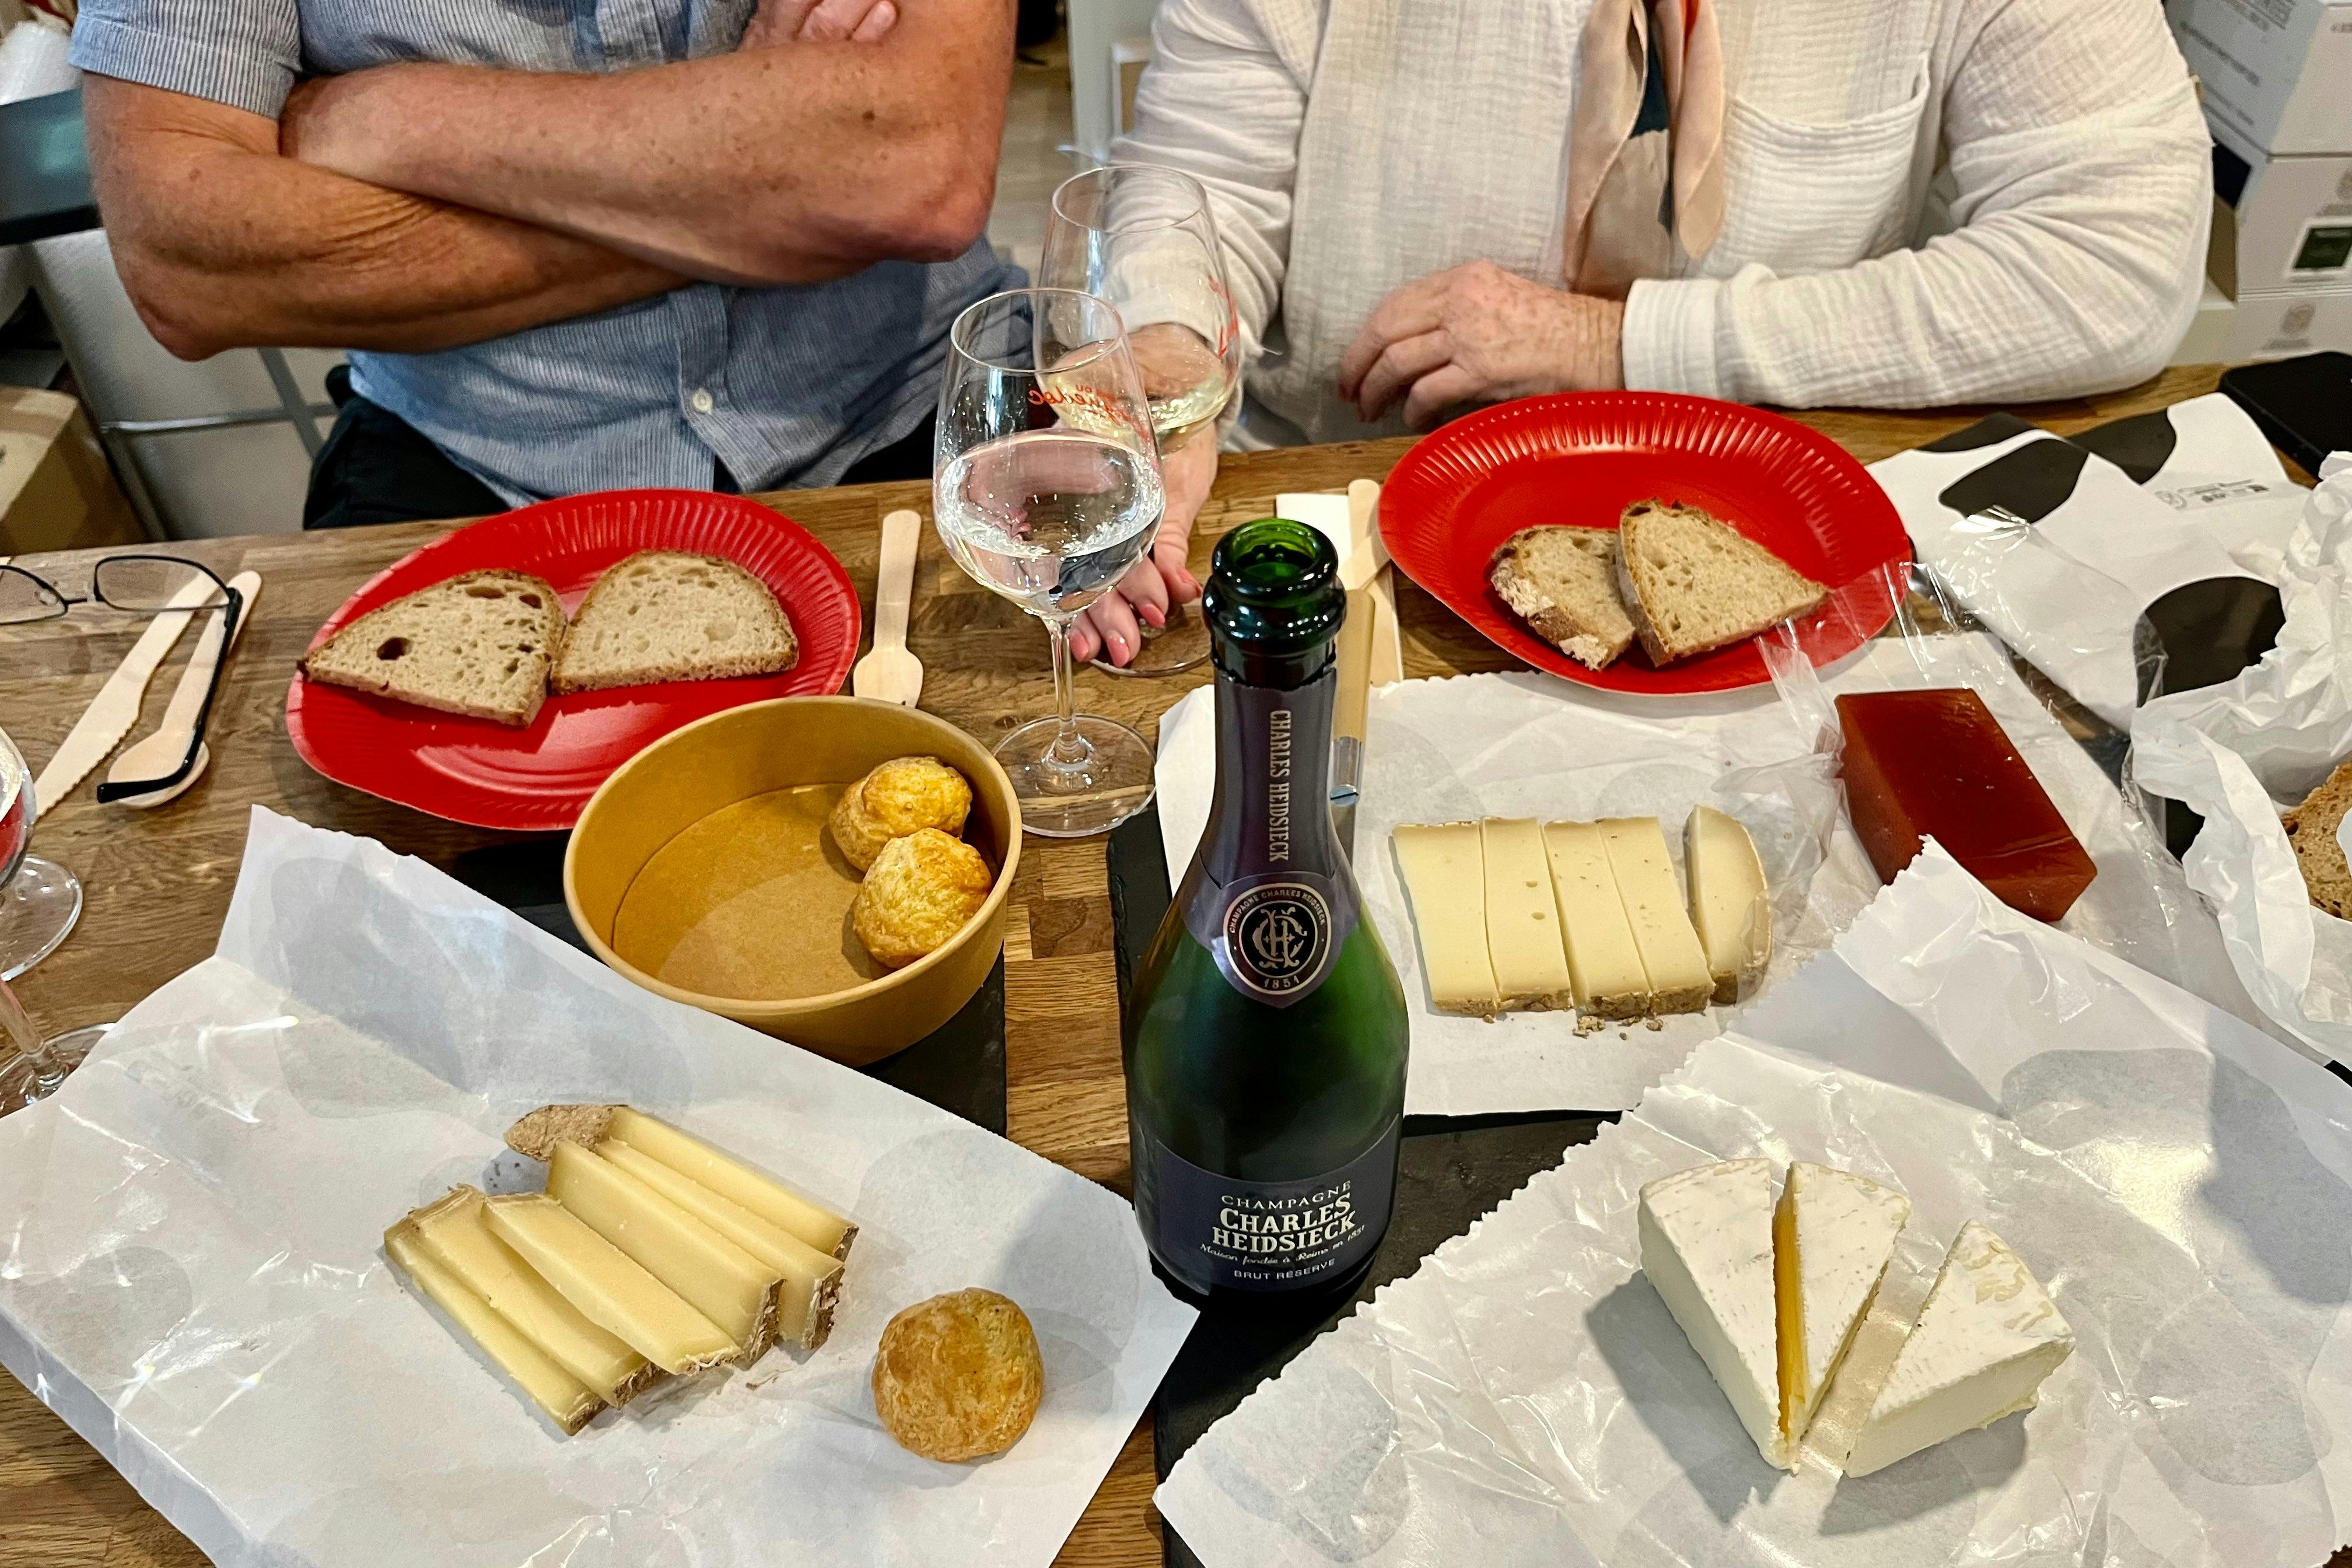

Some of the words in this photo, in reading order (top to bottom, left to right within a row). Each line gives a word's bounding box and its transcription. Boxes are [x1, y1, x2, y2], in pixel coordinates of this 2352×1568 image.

[1270, 709, 1291, 778] CHARLES
[1269, 782, 1289, 862] HEIDSIECK
[1229, 894, 1259, 933] CHAMPAGNE
[1261, 889, 1301, 899] CHARLES
[1264, 975, 1300, 989] 1851
[1219, 1192, 1352, 1234] CHARLES
[1221, 1180, 1352, 1209] CHAMPAGNE
[1199, 1242, 1238, 1262] Maison
[1295, 1248, 1329, 1261] Reims
[1212, 1209, 1357, 1254] HEIDSIECK
[1234, 1269, 1271, 1280] BRUT
